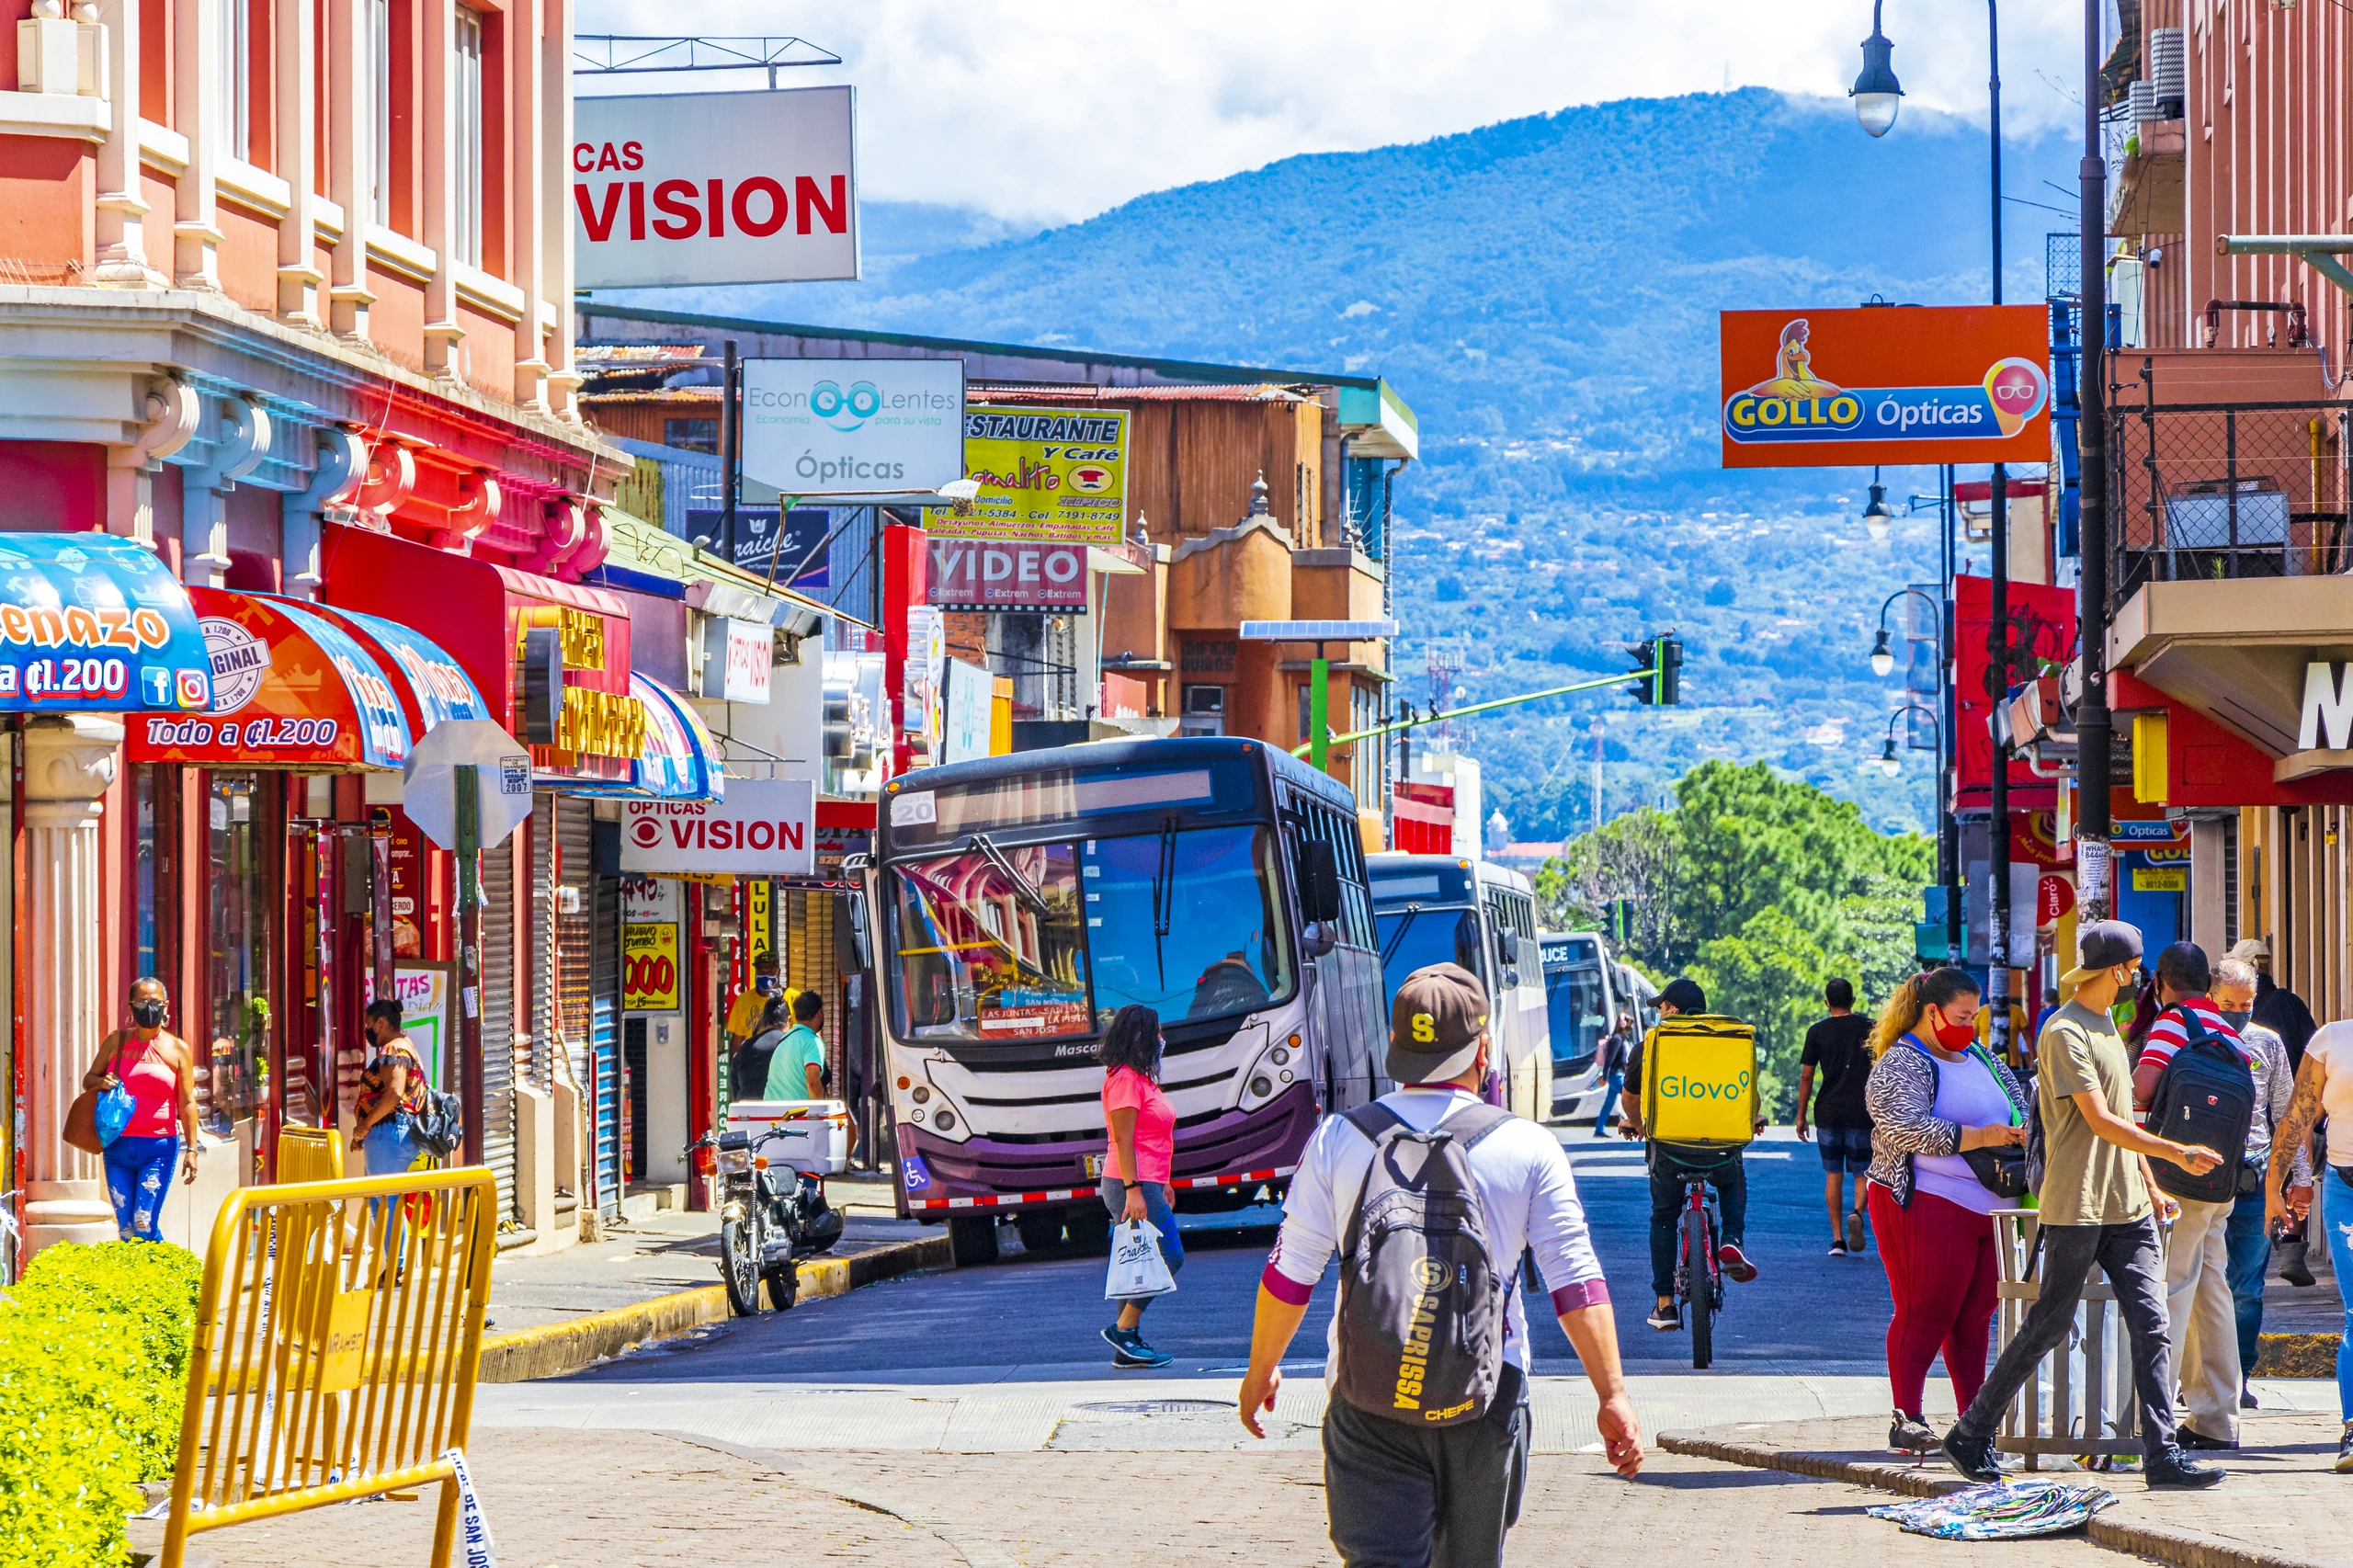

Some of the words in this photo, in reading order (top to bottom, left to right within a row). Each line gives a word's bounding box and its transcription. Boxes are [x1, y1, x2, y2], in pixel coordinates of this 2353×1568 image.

[574, 174, 847, 242] VISION
[756, 414, 810, 425] Economía
[875, 415, 901, 426] para
[904, 416, 915, 426] su
[917, 415, 942, 426] vista
[1733, 396, 1859, 426] GOLLO
[1876, 394, 1983, 431] Ópticas
[1042, 447, 1060, 460] Y
[1063, 447, 1120, 461] Café
[796, 449, 904, 483] Ópticas
[964, 457, 1060, 491] omalito
[974, 494, 1014, 506] Domicilio
[936, 517, 985, 528] Desayunos,
[988, 520, 1038, 529] Almuerzos,
[1040, 522, 1093, 531] Empanadas,
[1057, 511, 1120, 520] 7191-8749
[715, 526, 795, 557] raiche
[932, 550, 1079, 583] VIDEO
[938, 587, 972, 597] Extrem
[995, 588, 1029, 597] Extrem
[1047, 589, 1081, 598] Extrem
[147, 718, 212, 745] Todo
[219, 722, 239, 744] a
[506, 783, 527, 792] 2007
[897, 802, 933, 823] 20
[670, 819, 804, 850] VISION
[2129, 824, 2168, 837] Ópticas
[982, 1011, 1000, 1019] LAS
[1002, 1008, 1036, 1017] JUNTAS
[1013, 1028, 1033, 1036] SAN
[1412, 1013, 1435, 1042] S
[1660, 1075, 1740, 1100] Glovo
[1393, 1293, 1439, 1410] SAPRISSA
[1425, 1399, 1474, 1421] CHEPE
[465, 1515, 483, 1544] SAN
